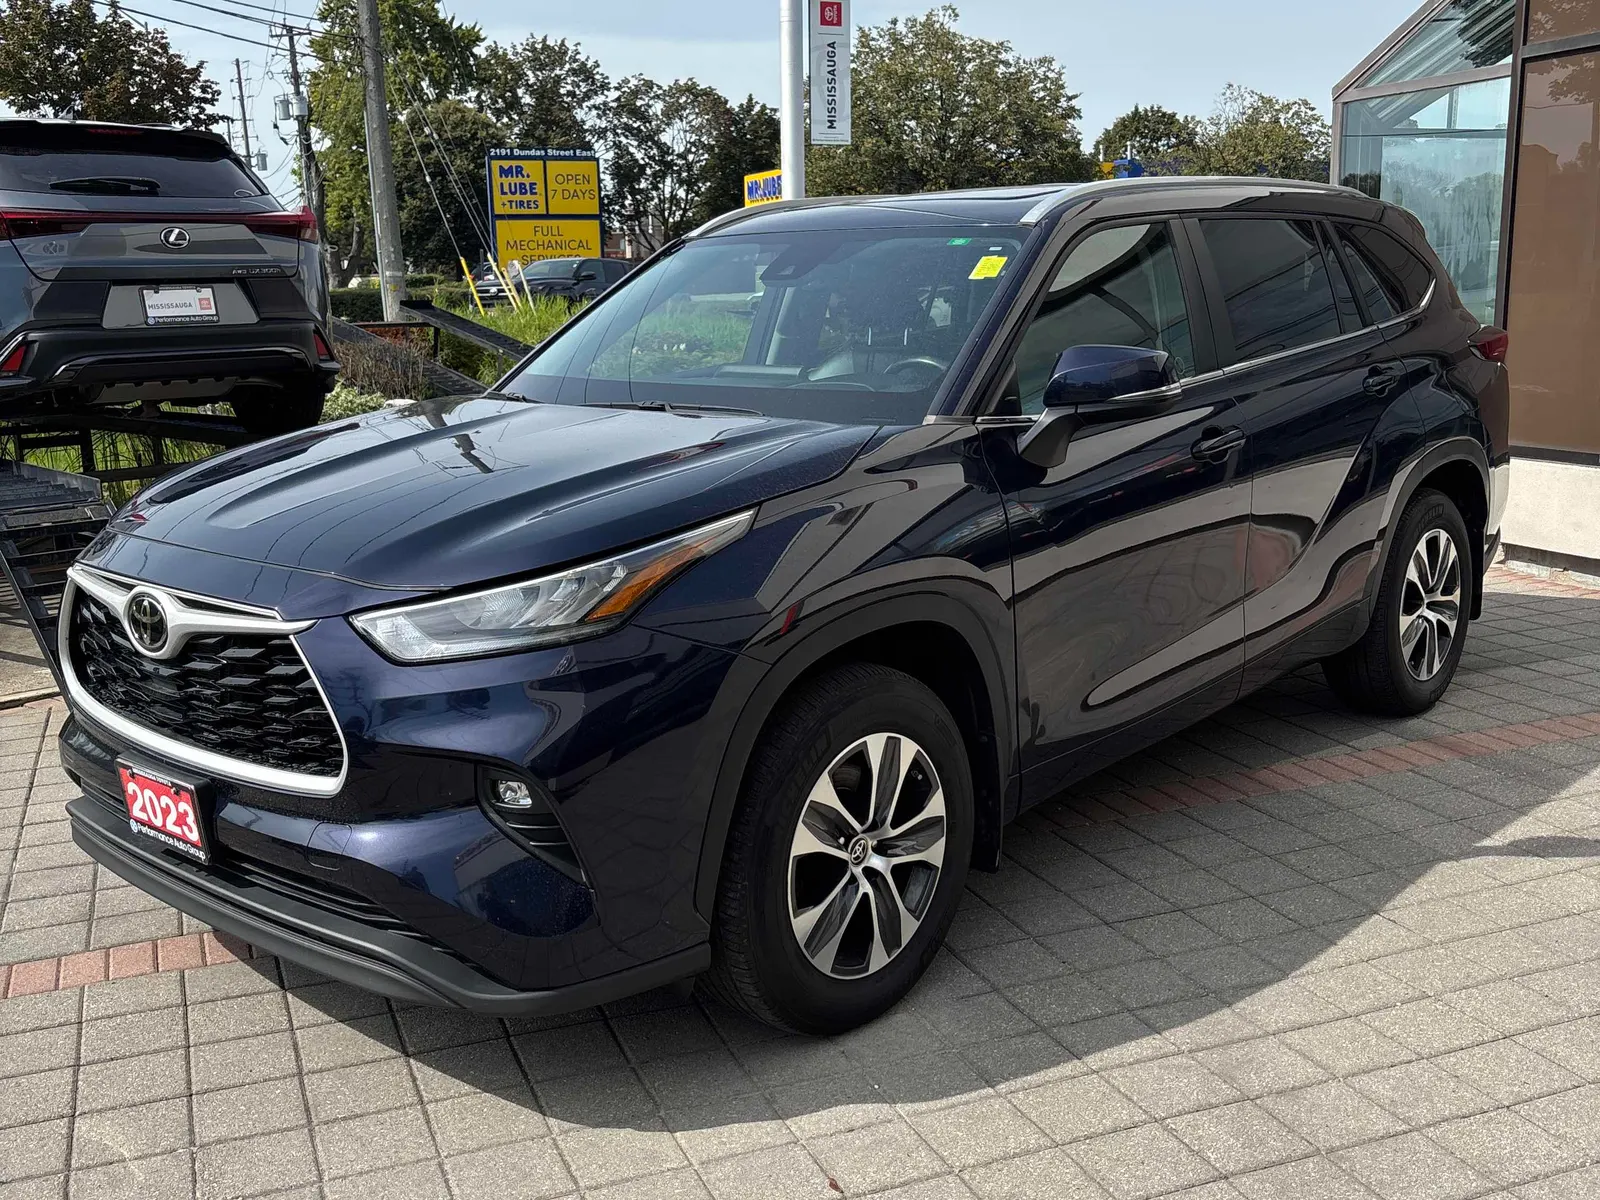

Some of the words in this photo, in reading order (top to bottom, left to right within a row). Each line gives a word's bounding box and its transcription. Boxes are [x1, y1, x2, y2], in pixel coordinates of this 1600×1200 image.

[827, 41, 837, 129] MISSISSAUGA
[498, 165, 531, 178] MR.
[555, 174, 590, 185] OPEN
[500, 182, 538, 196] LUBE
[551, 189, 557, 199] 7
[562, 189, 596, 200] DAYS
[533, 226, 564, 237] FULL
[506, 240, 592, 251] MECHANICAL
[148, 302, 193, 310] MISSISSAUGA
[127, 782, 199, 842] 2023
[138, 823, 173, 846] Performance
[174, 838, 187, 852] Auto
[187, 843, 206, 861] Group
